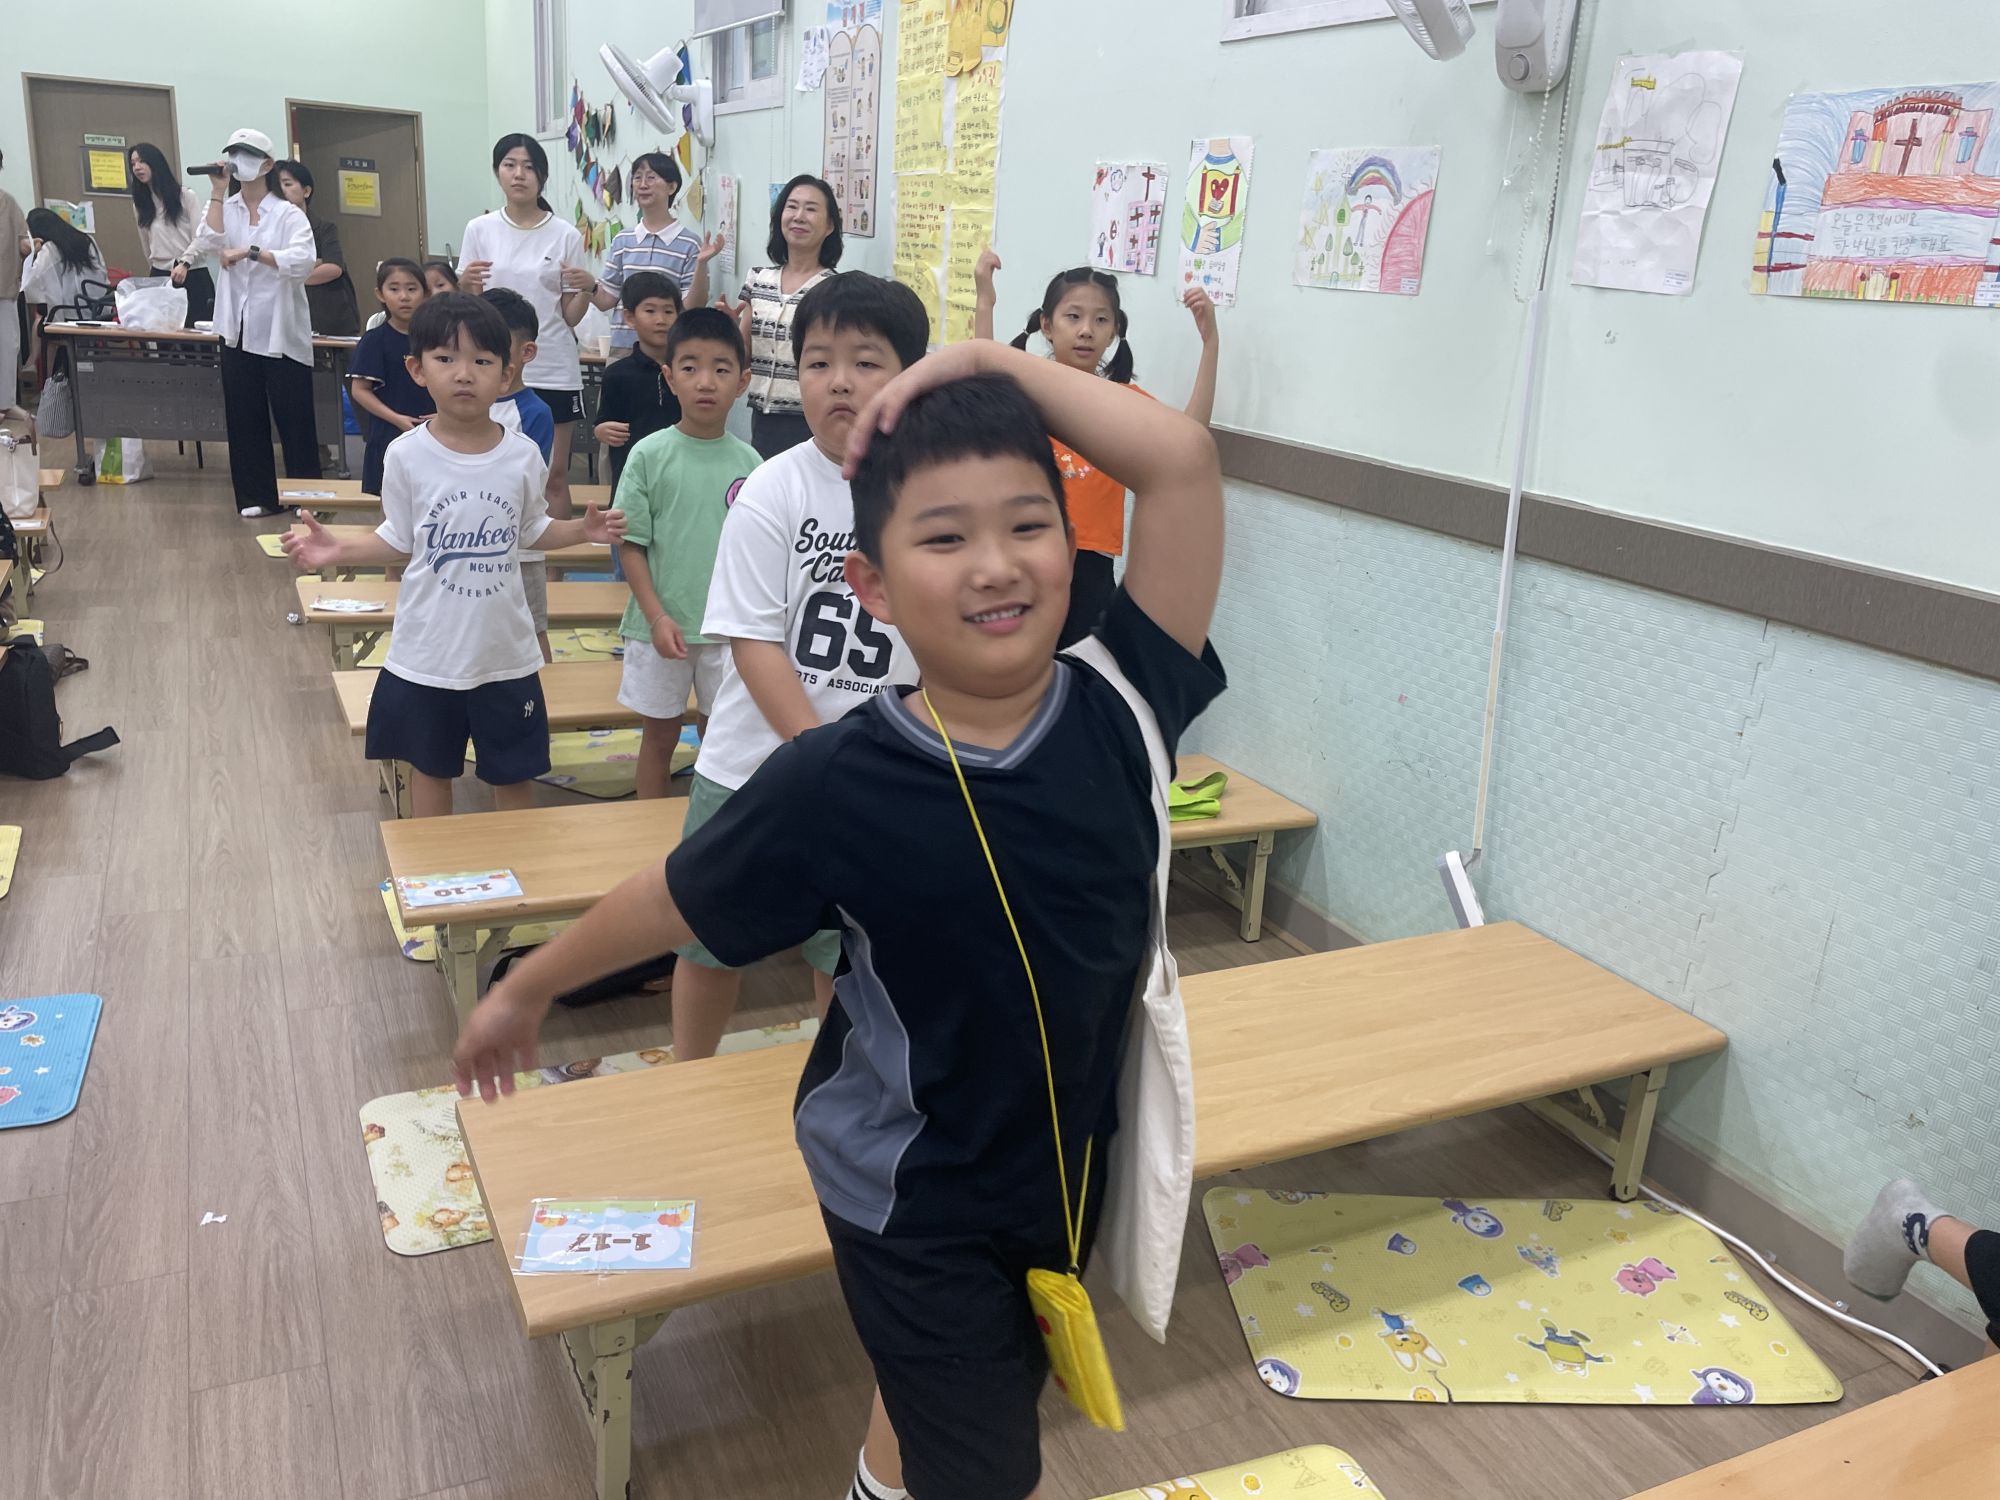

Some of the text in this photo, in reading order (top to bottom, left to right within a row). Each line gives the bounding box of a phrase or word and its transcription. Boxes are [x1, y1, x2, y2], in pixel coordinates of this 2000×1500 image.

[1832, 236, 1888, 257] 하나님을
[429, 491, 467, 519] MAJOR
[421, 515, 517, 566] Yankees
[795, 518, 858, 553] Sout
[498, 564, 512, 572] YO
[811, 552, 846, 583] Ca
[795, 592, 893, 679] 65
[434, 882, 492, 897] 1-10
[566, 1232, 652, 1252] 1-17
